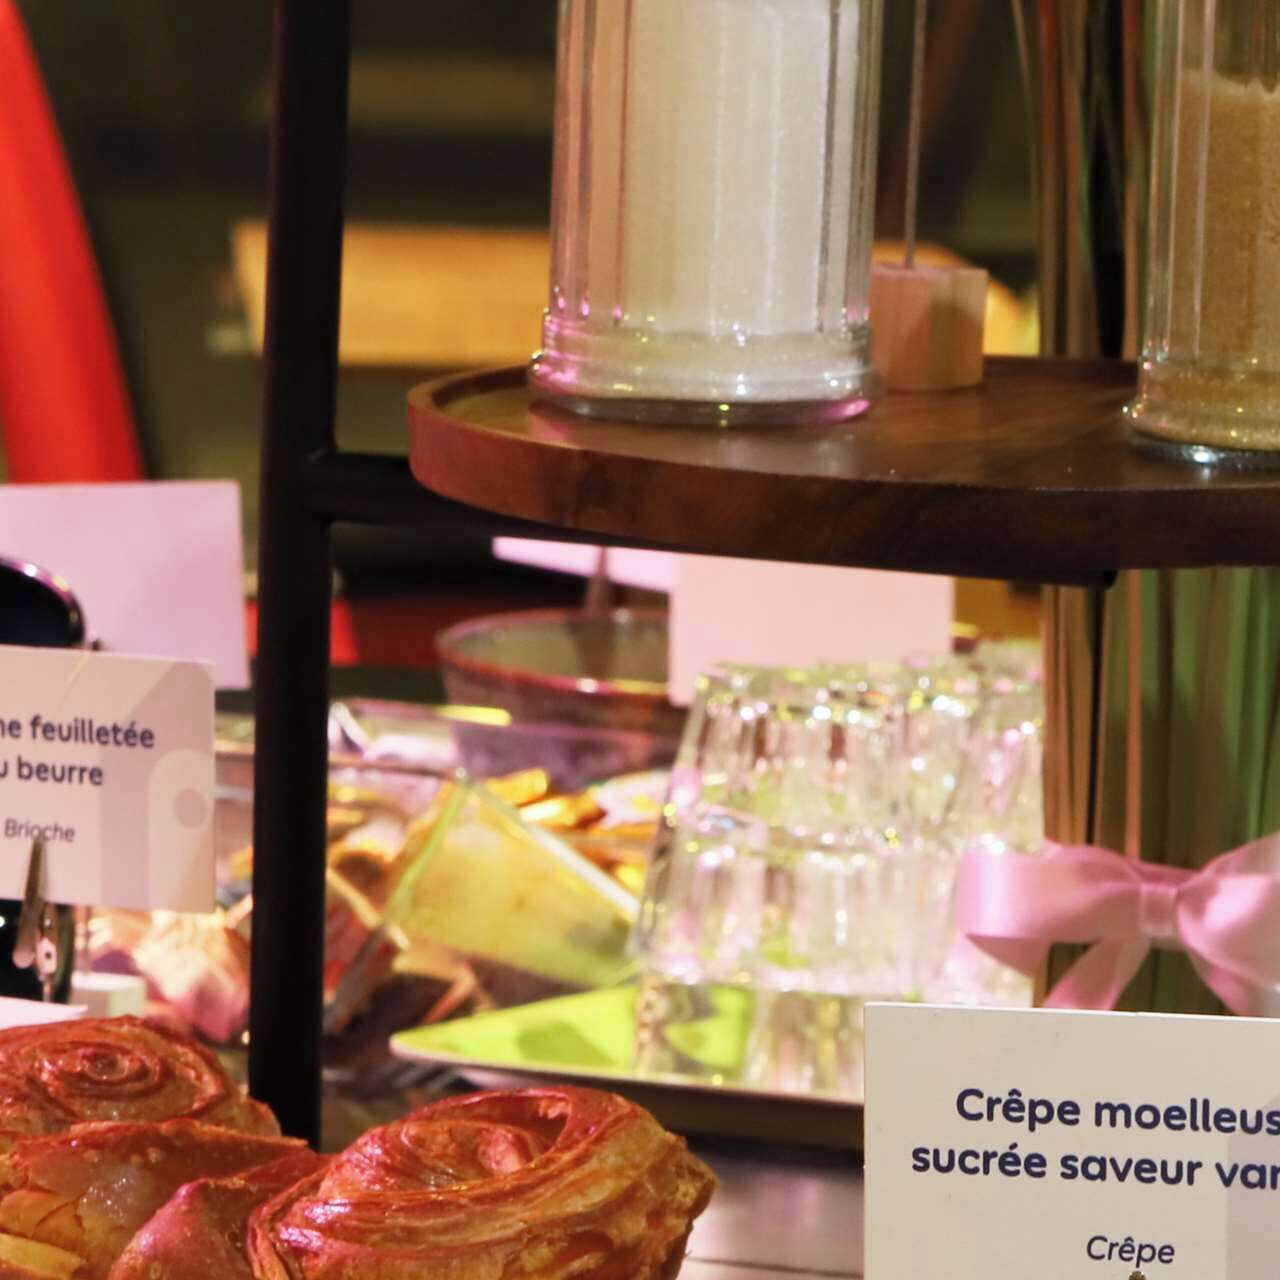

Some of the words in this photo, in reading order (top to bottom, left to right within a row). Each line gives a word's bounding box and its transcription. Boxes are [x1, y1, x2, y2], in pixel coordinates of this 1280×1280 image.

[29, 714, 155, 749] feuilletée
[16, 755, 104, 787] beurre
[4, 817, 76, 843] Brioche
[956, 1088, 1081, 1133] Crêpe
[911, 1142, 1048, 1179] sucrée
[1060, 1154, 1203, 1187] saveur
[1086, 1235, 1176, 1269] Crêpe
